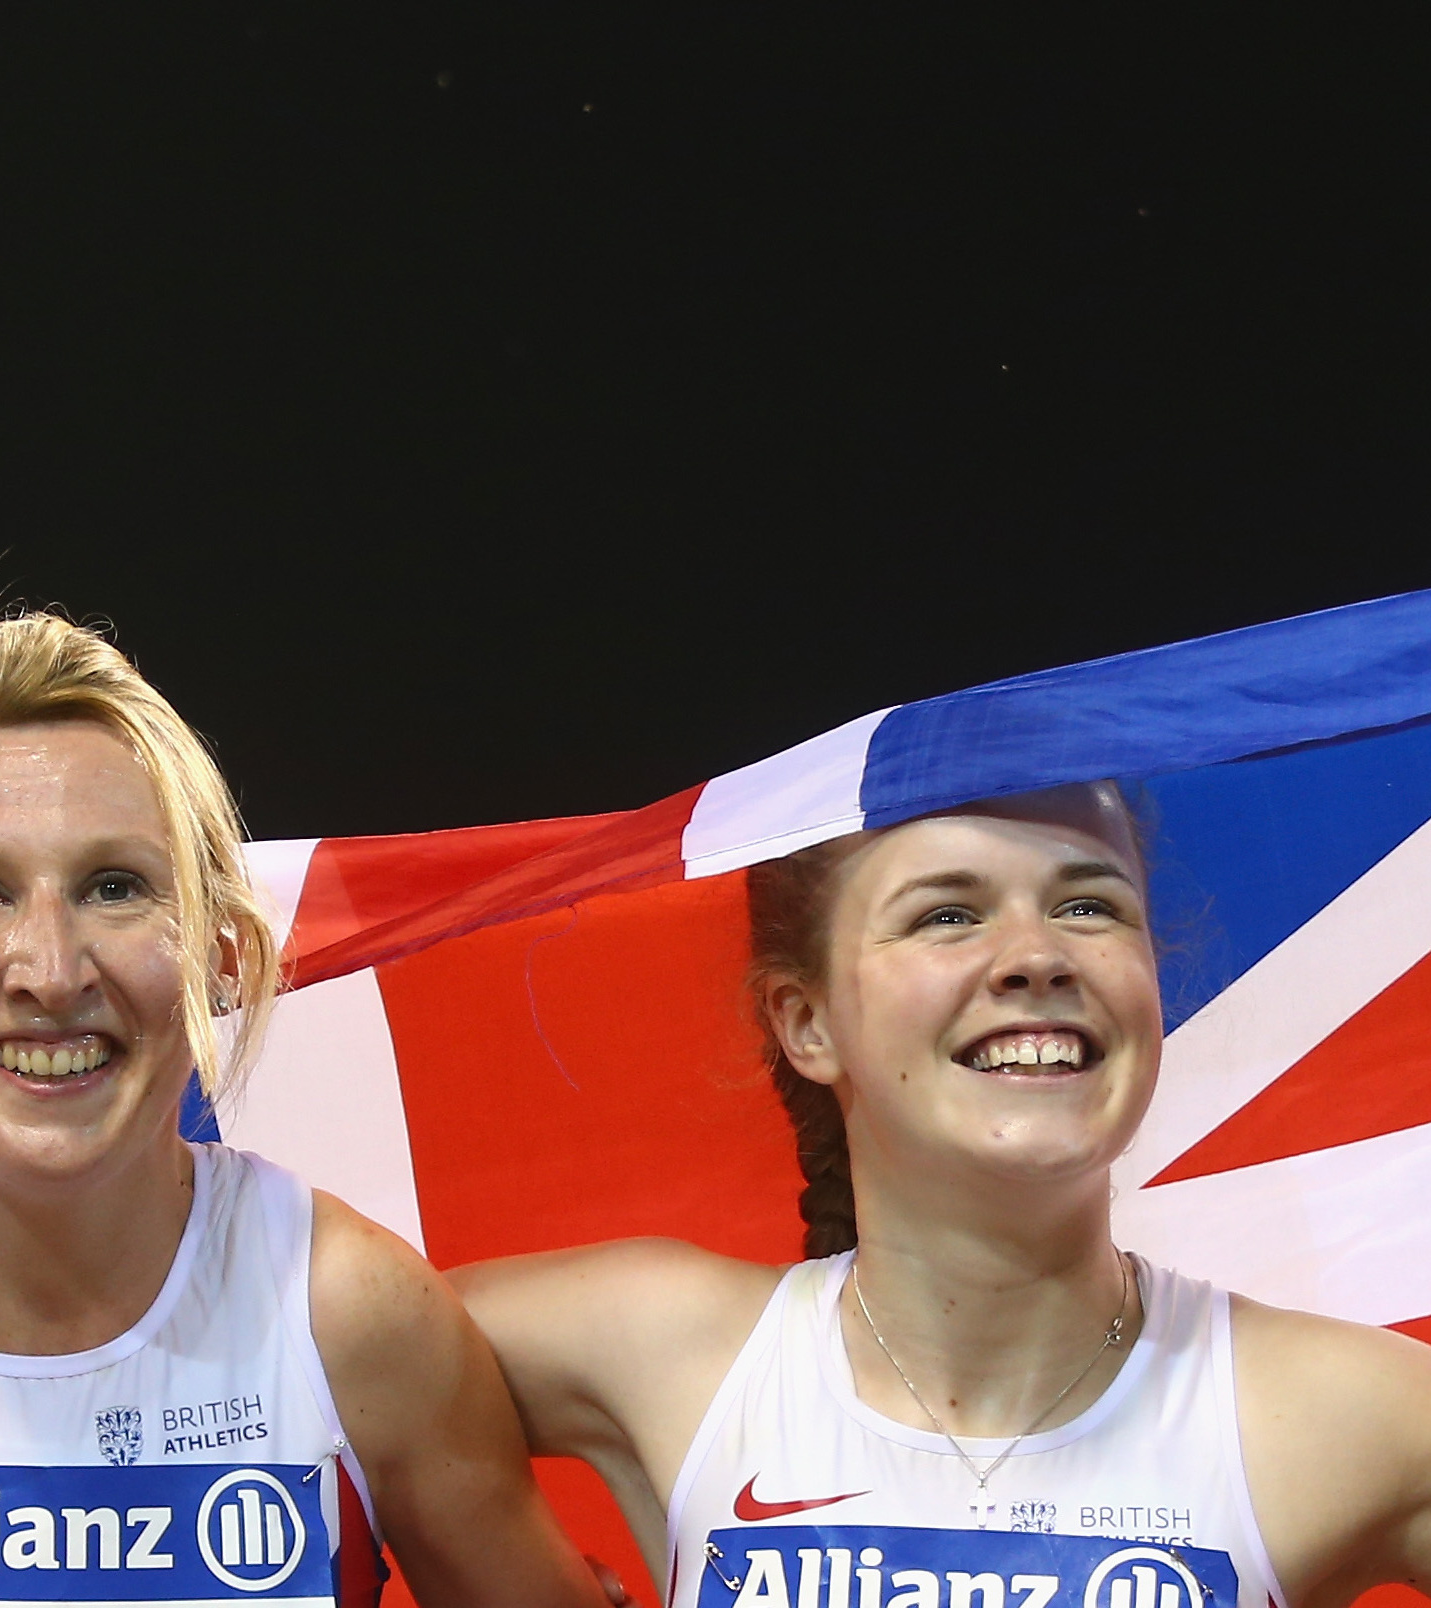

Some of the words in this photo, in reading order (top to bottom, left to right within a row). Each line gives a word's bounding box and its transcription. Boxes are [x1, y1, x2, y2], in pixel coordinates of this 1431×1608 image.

[162, 1394, 263, 1431] BRITISH
[163, 1422, 268, 1455] ATHLETICS
[1080, 1506, 1191, 1529] BRITISH
